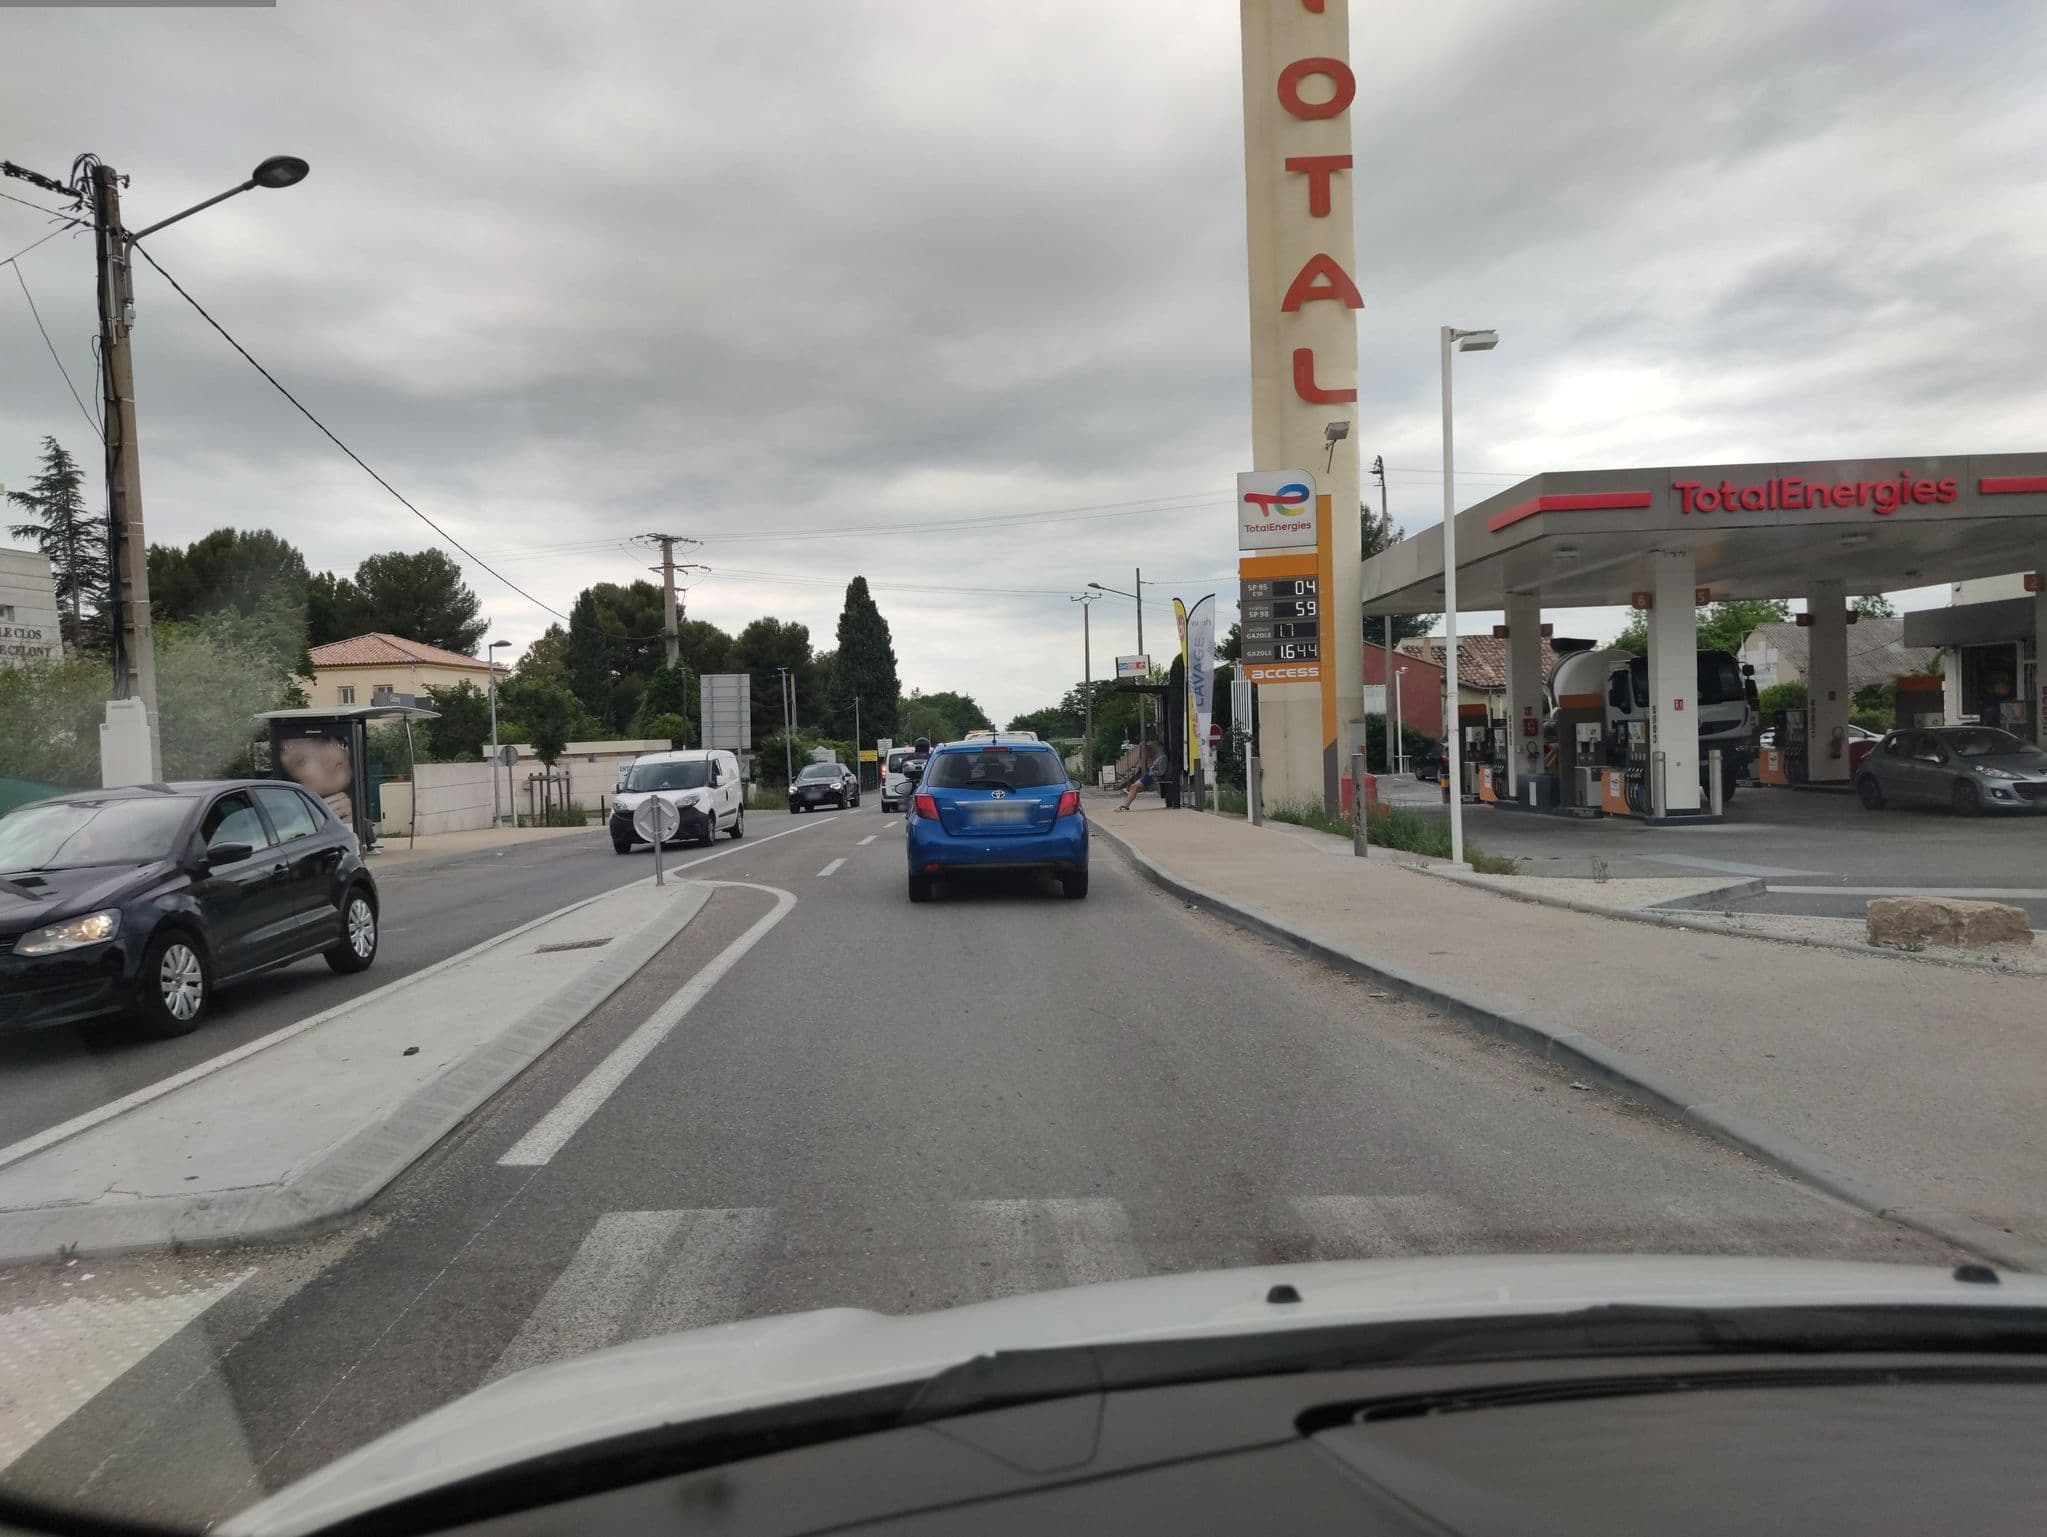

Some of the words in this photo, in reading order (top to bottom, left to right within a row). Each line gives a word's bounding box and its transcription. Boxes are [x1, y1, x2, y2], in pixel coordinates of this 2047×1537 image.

[1672, 469, 1958, 516] TotalEnergies
[1244, 521, 1312, 534] TotalEnergies
[1295, 580, 1316, 595] 04
[1638, 595, 1645, 606] 6
[1259, 610, 1269, 618] 98
[1296, 601, 1316, 616] 59
[14, 628, 42, 640] CLOS
[1192, 637, 1205, 706] LAVAGE
